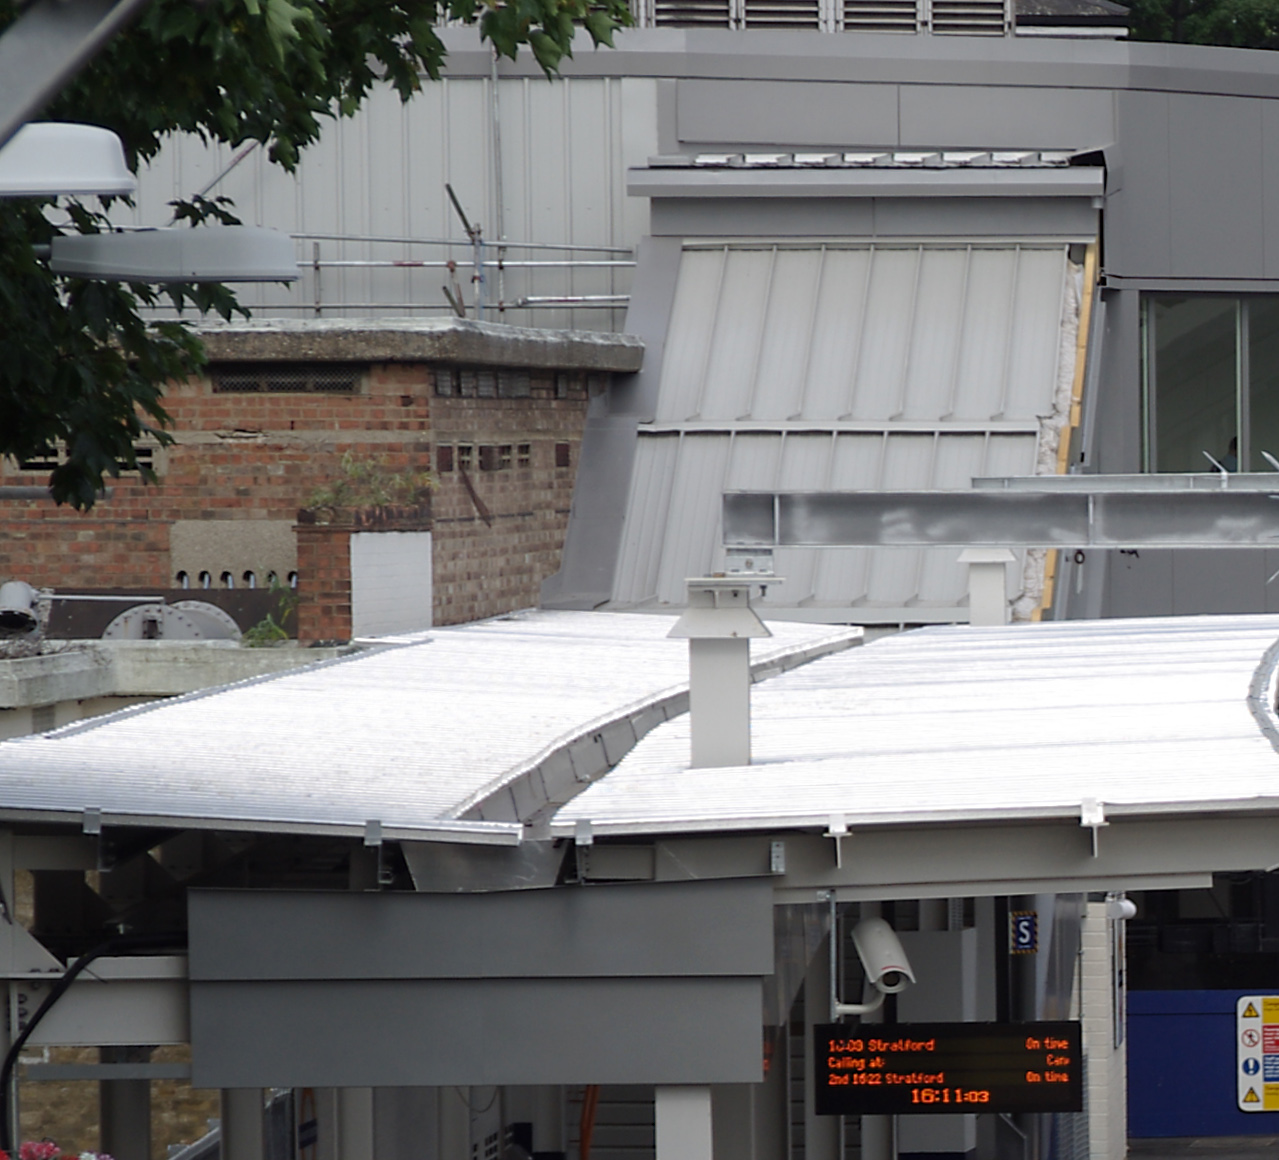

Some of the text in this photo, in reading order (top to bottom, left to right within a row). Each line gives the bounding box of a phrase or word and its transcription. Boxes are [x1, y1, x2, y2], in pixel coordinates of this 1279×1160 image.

[1018, 920, 1030, 944] S
[868, 1038, 935, 1052] Stratford
[1025, 1036, 1040, 1050] On
[1043, 1036, 1070, 1050] time
[827, 1056, 866, 1071] Calling
[828, 1073, 849, 1085] 2nd
[885, 1072, 944, 1085] Stratford
[1025, 1070, 1041, 1083] On
[1044, 1070, 1069, 1083] time
[911, 1087, 990, 1104] 16:11:03
